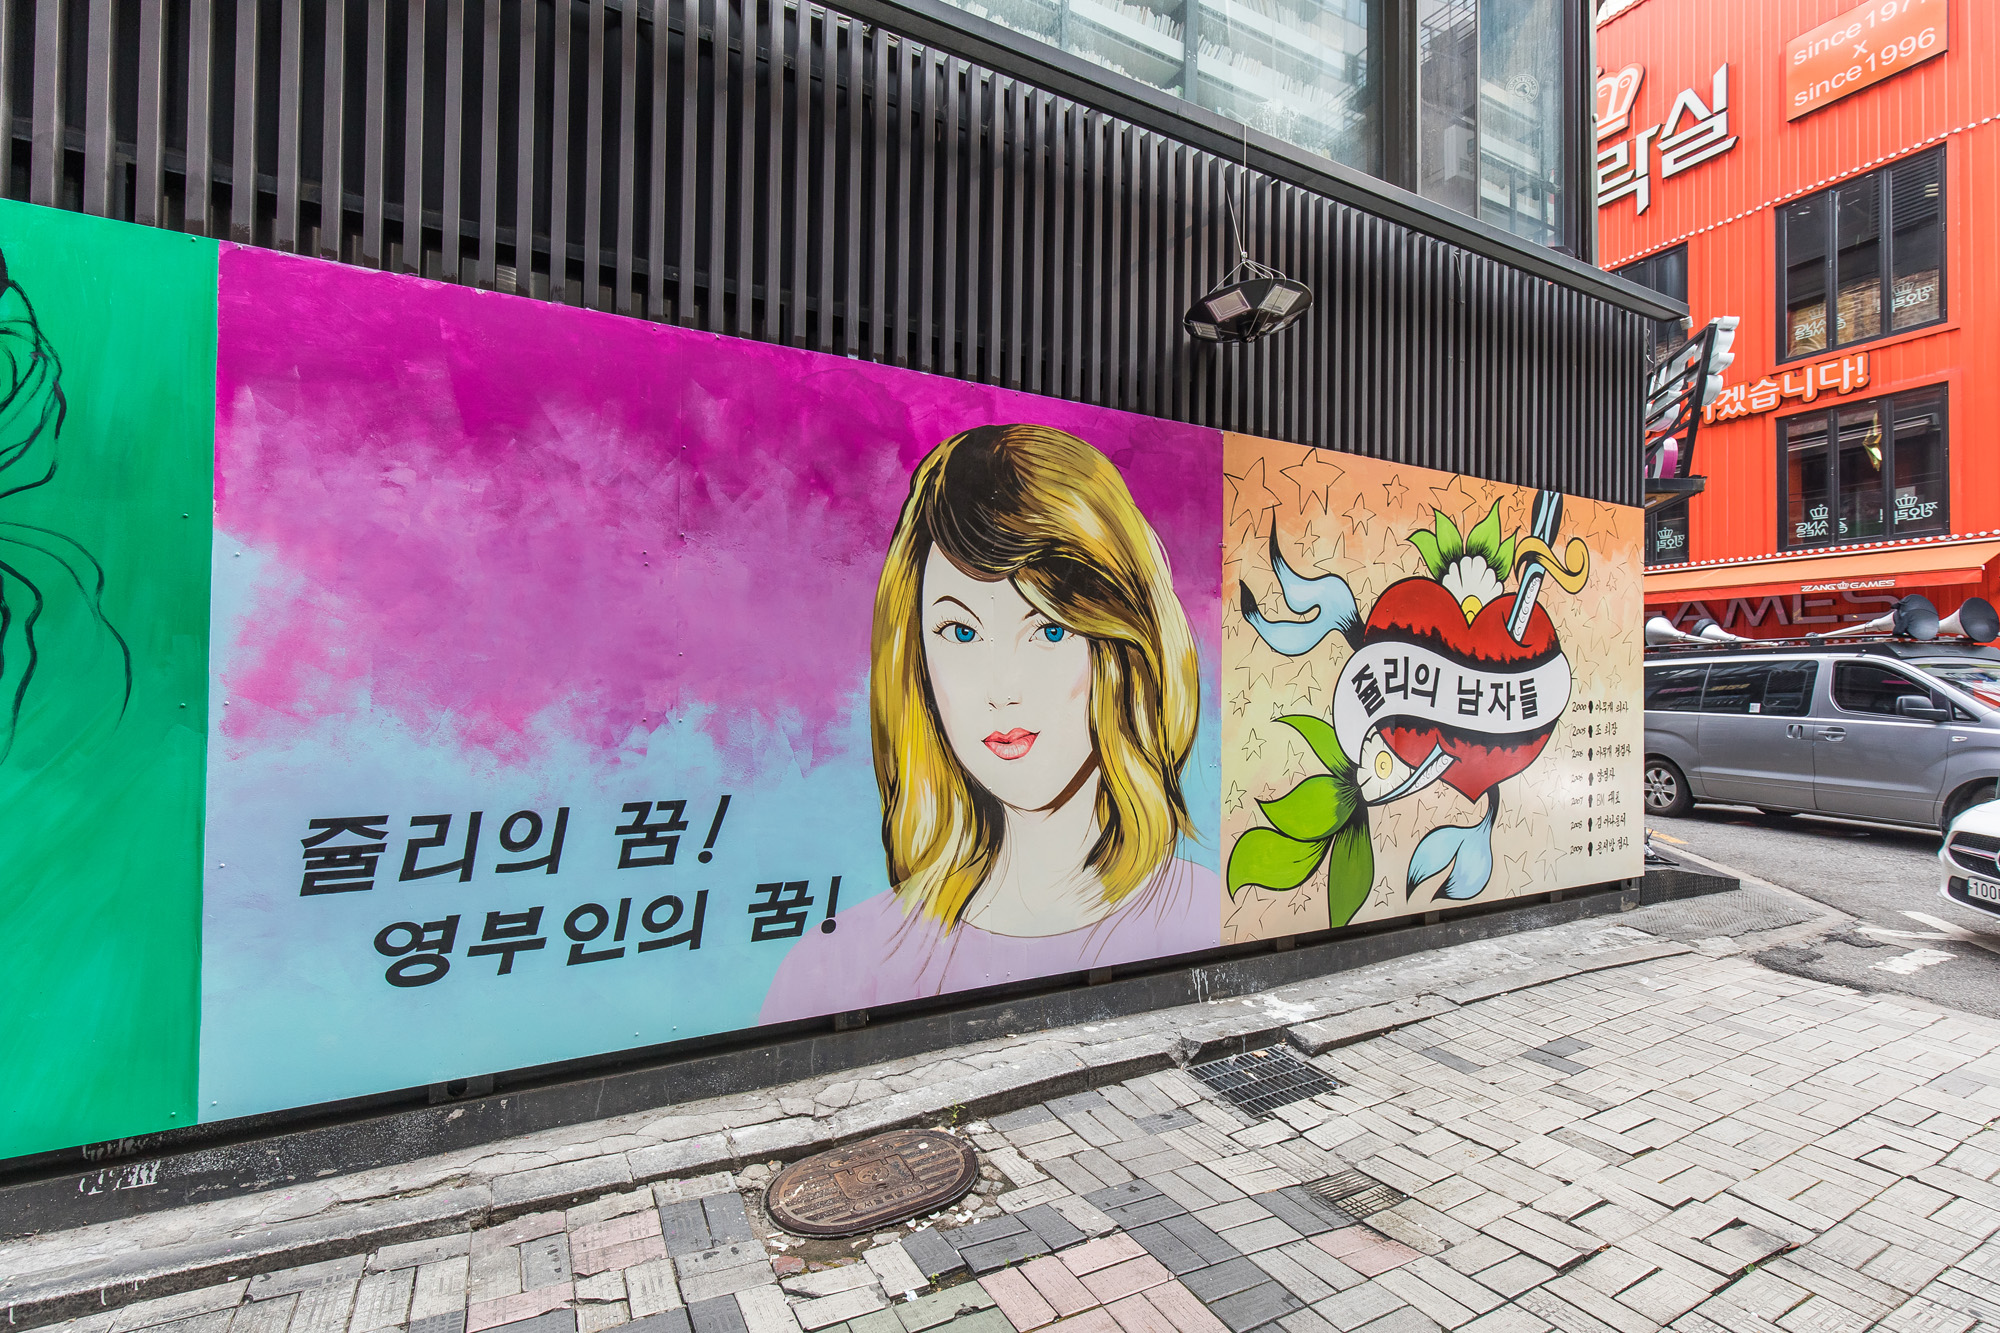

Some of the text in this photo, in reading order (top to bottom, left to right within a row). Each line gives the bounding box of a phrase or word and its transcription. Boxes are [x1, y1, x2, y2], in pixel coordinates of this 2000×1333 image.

[1801, 579, 1896, 592] ZZANG GAMES
[1645, 592, 1898, 627] AMES
[1457, 675, 1538, 721] 남자들
[1572, 701, 1587, 713] 2000
[299, 794, 732, 897] 쥴리의 꿈!
[1973, 882, 2000, 900] 100
[373, 876, 842, 988] 영부인의 꿈!
